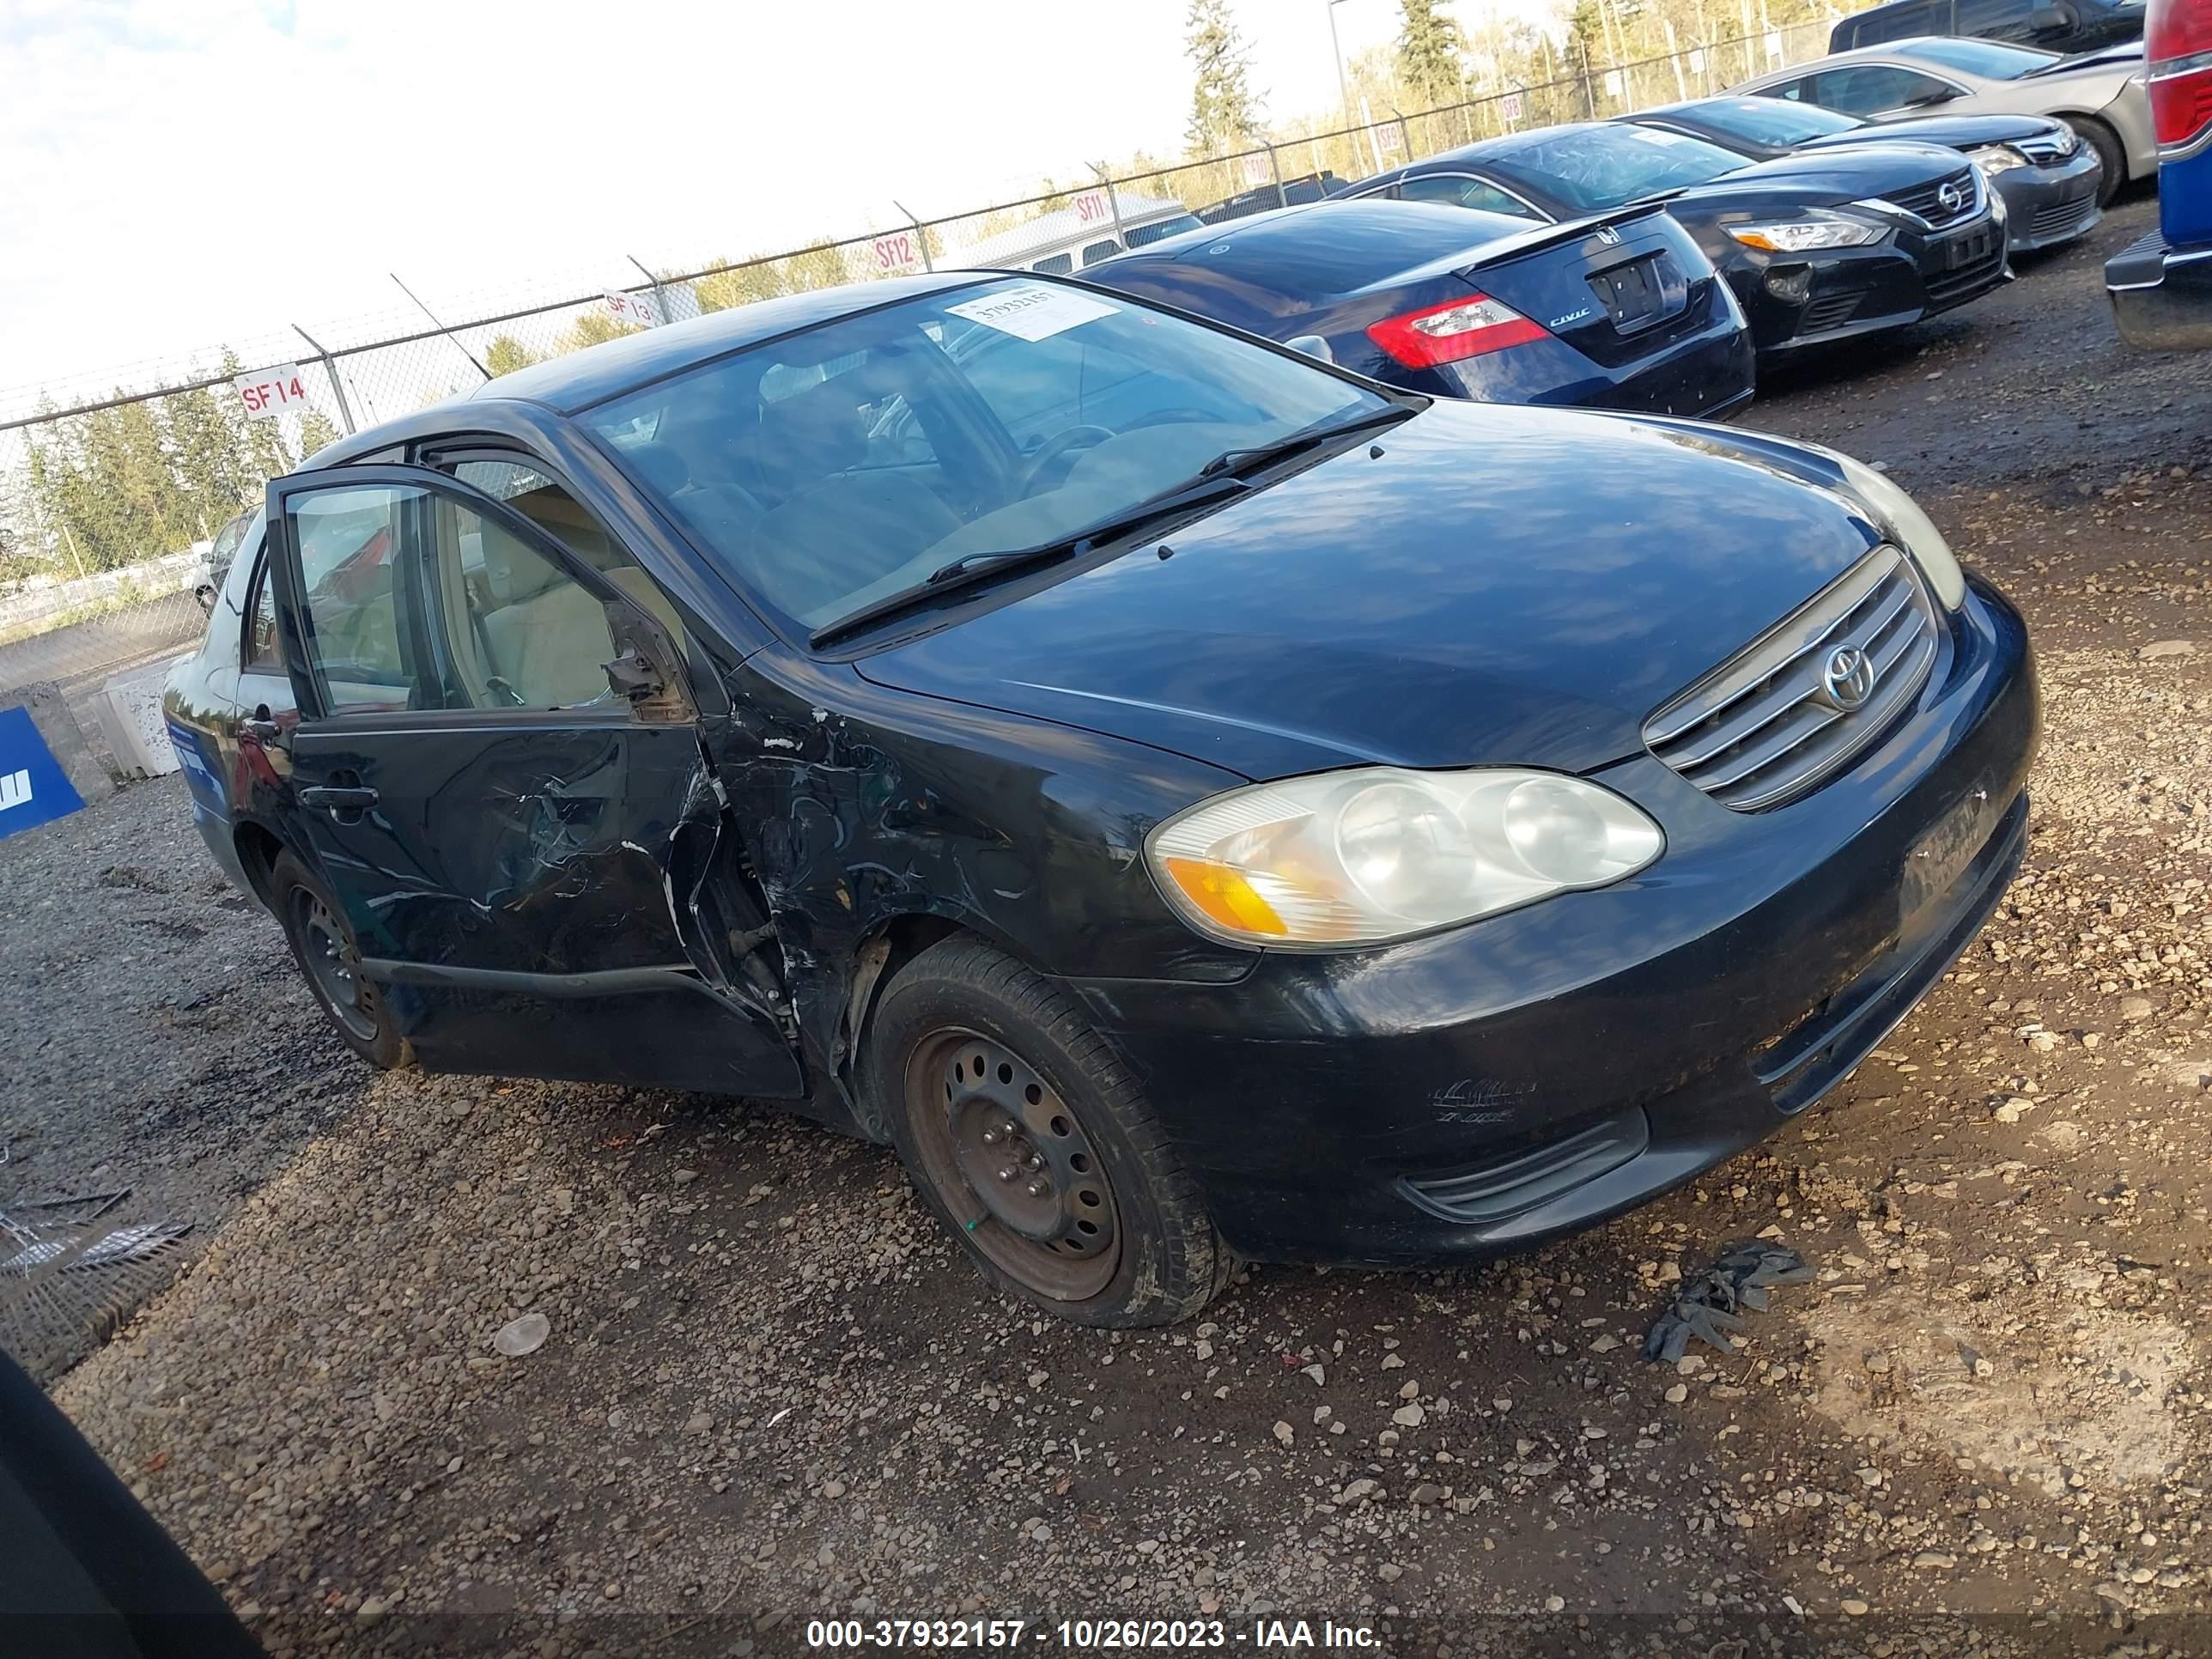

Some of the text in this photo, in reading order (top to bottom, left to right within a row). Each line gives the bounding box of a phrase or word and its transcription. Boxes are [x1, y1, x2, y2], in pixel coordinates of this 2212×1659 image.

[1380, 127, 1398, 149] SF9
[1076, 194, 1105, 221] SF11
[876, 236, 914, 269] SF12
[975, 292, 1057, 320] 37932157
[1550, 307, 1590, 327] CIVIC
